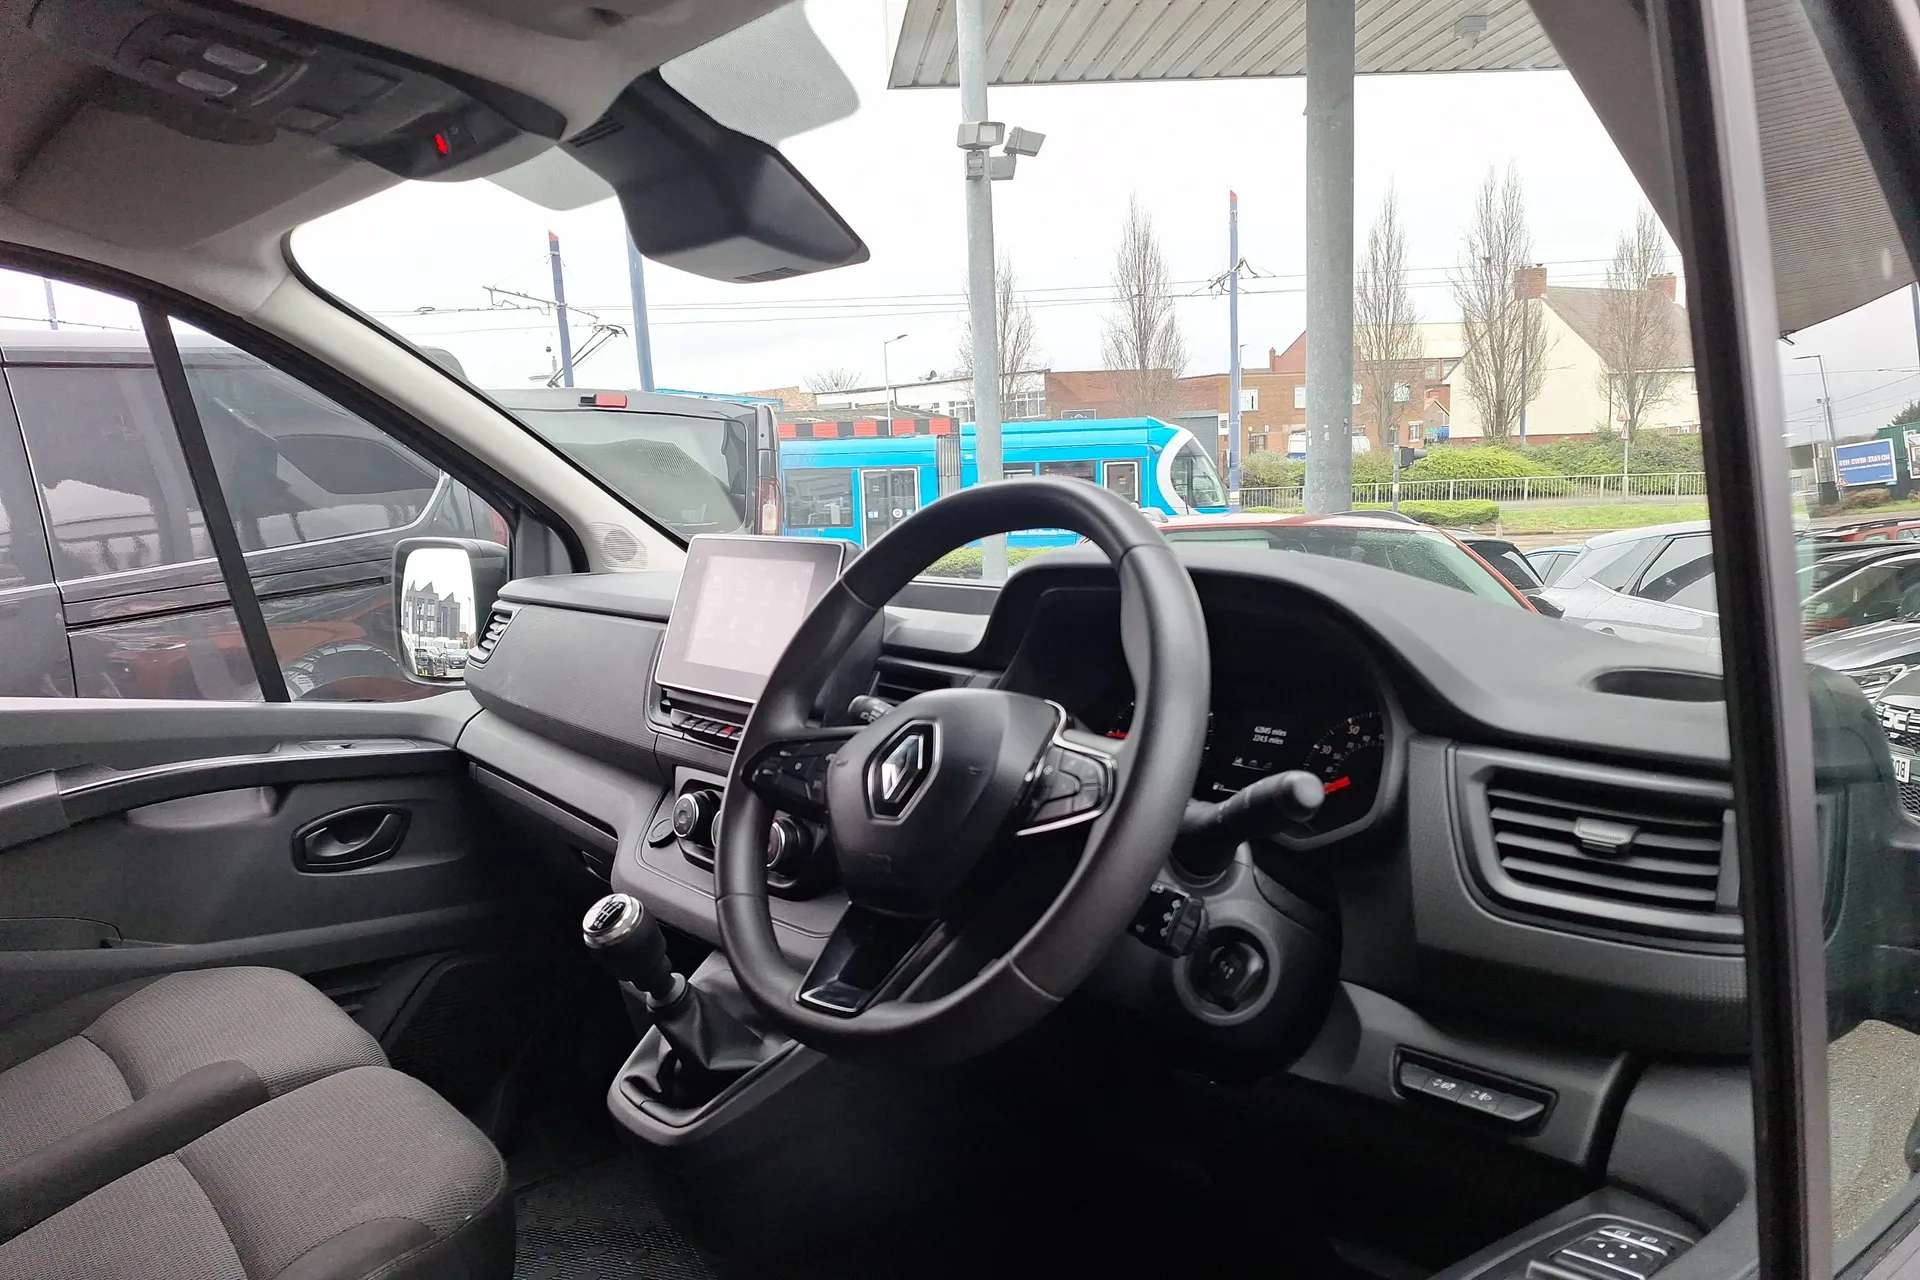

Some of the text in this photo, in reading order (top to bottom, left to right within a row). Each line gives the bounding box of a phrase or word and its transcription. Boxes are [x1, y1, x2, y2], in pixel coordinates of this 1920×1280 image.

[1272, 729, 1287, 737] miles
[1348, 725, 1360, 735] 50
[1320, 745, 1332, 754] 30
